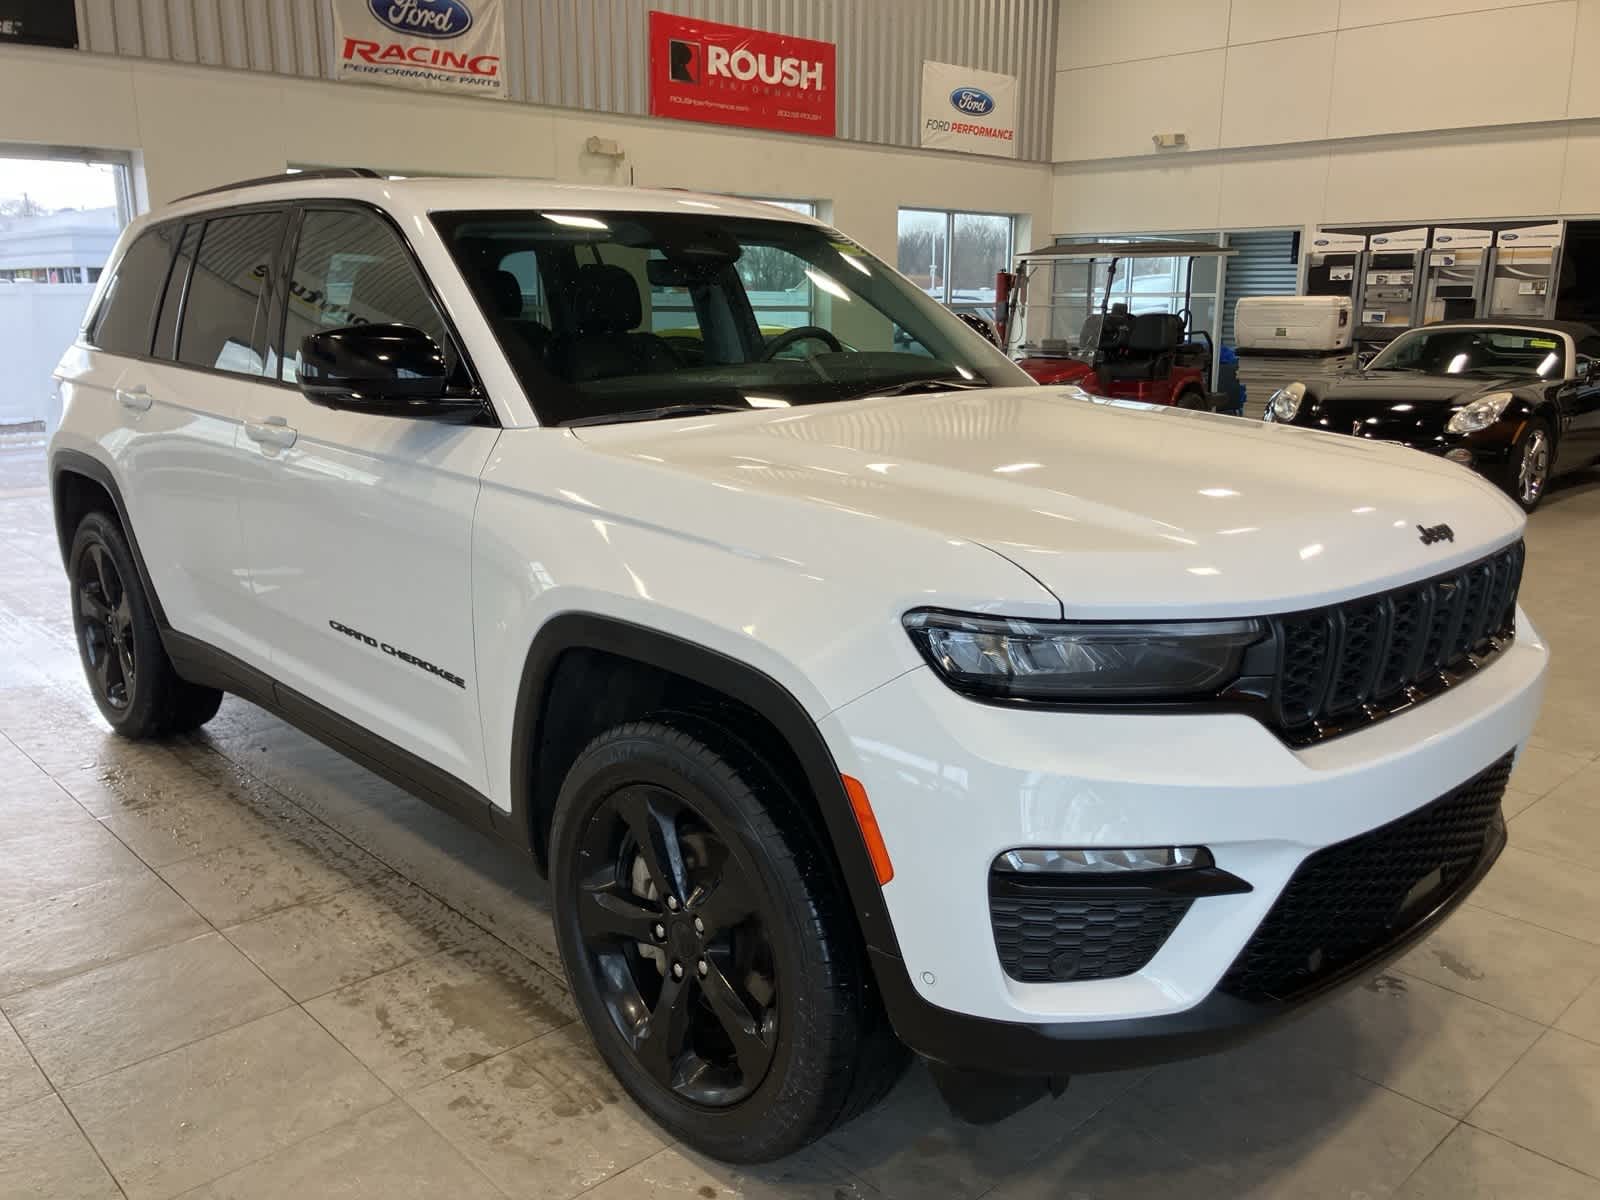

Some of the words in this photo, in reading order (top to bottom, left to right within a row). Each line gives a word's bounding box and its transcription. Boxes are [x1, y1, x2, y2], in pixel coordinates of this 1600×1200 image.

[388, 0, 452, 31] Ford
[343, 37, 500, 76] RACING
[707, 45, 824, 91] ROUSH
[343, 63, 456, 83] PERFORMANCE
[459, 77, 501, 88] PARTS
[958, 90, 988, 113] Ford
[926, 119, 950, 132] FORD
[950, 122, 1014, 141] PERFORMANCE
[1416, 523, 1455, 546] Jeep
[329, 620, 378, 648] GRAND
[380, 642, 466, 690] CHEROKEE
